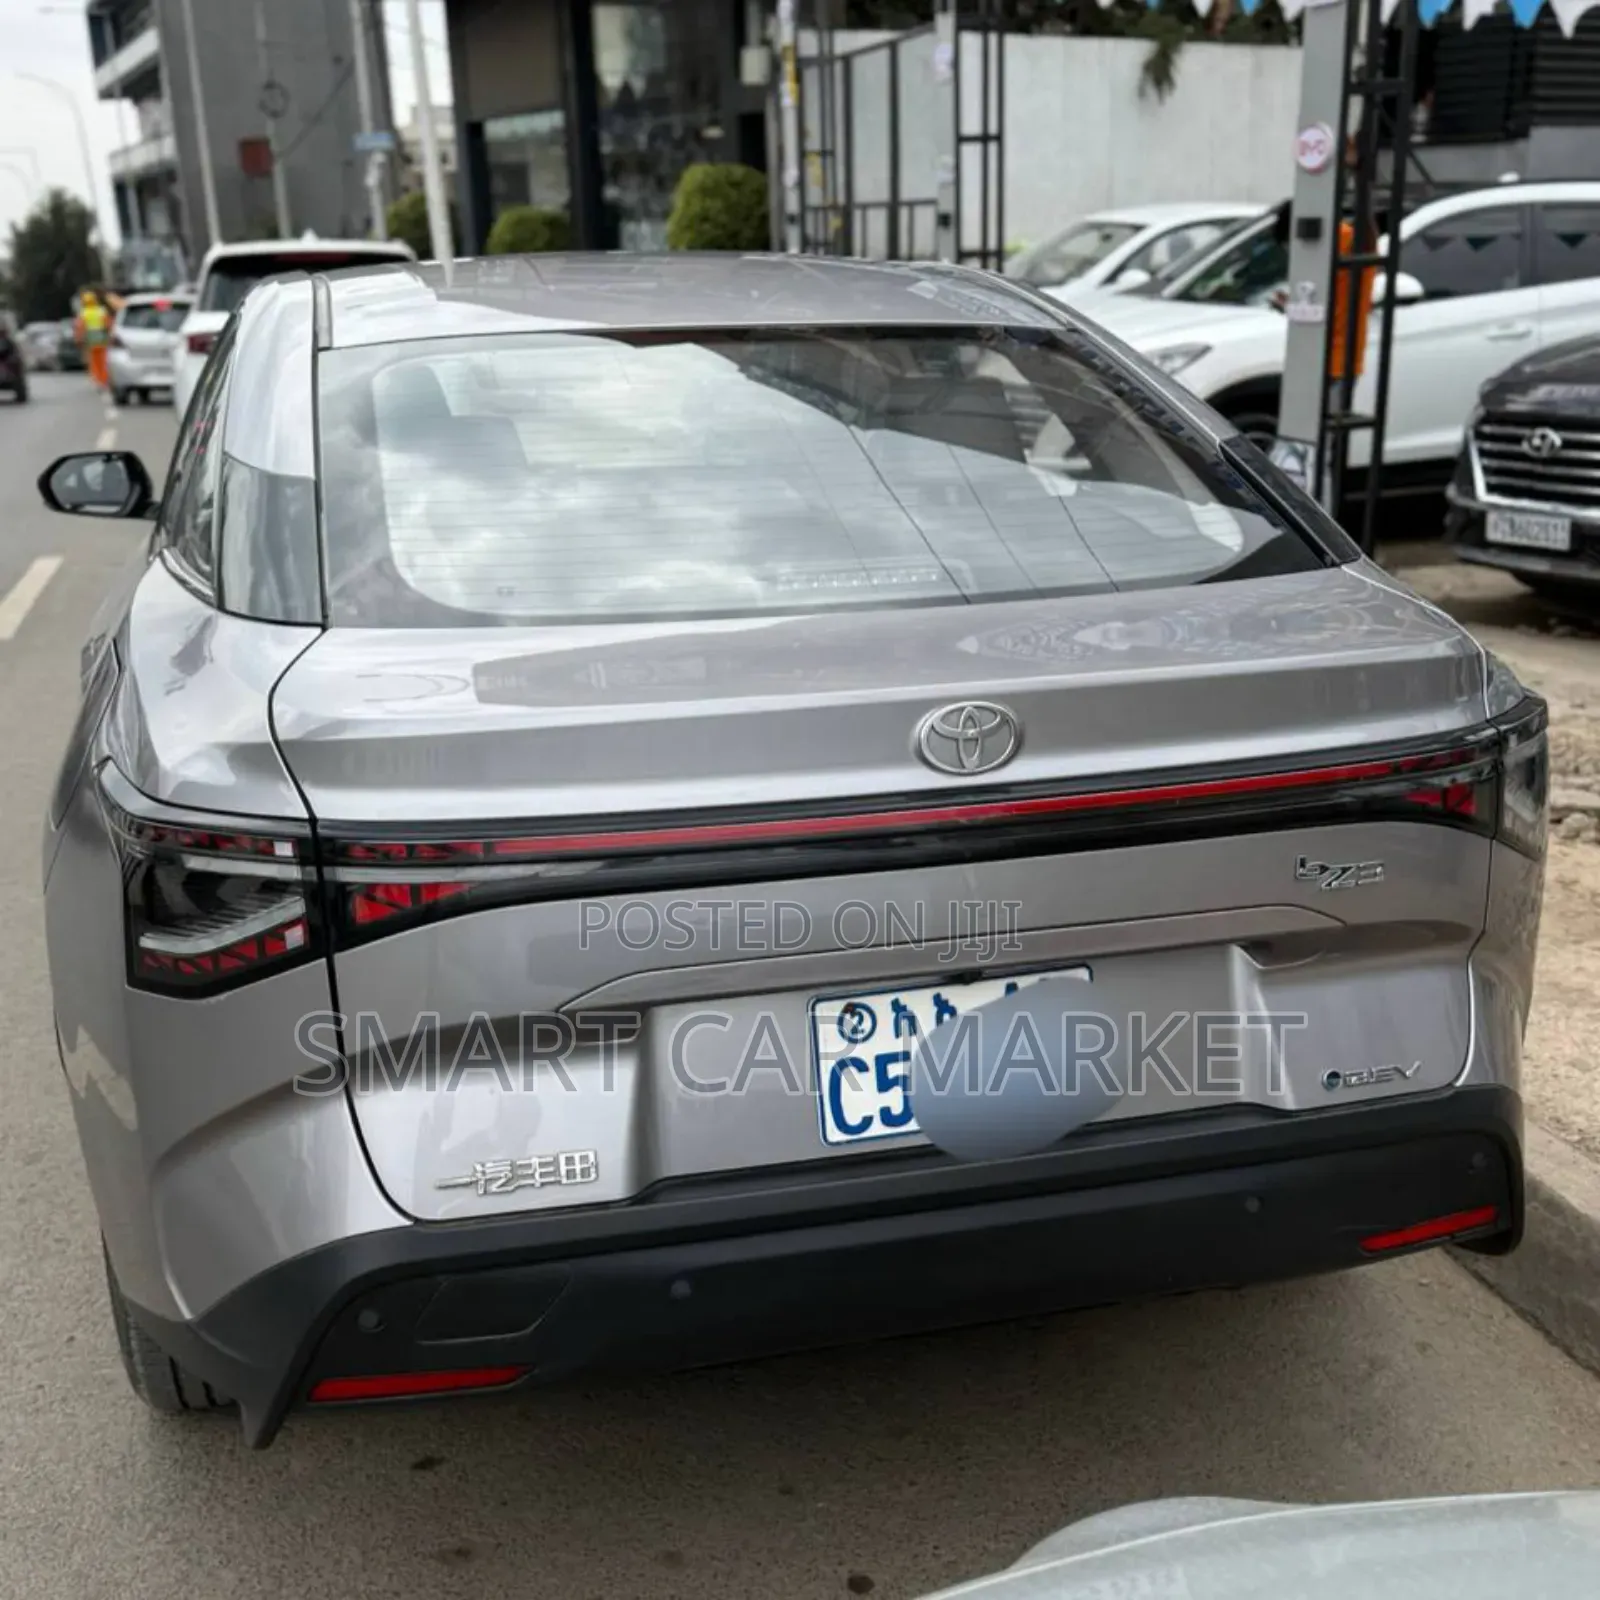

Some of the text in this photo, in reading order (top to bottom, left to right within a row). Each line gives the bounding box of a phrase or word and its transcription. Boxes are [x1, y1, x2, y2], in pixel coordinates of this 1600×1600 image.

[828, 1051, 915, 1136] C5
[435, 1150, 598, 1196] 一汽丰田
